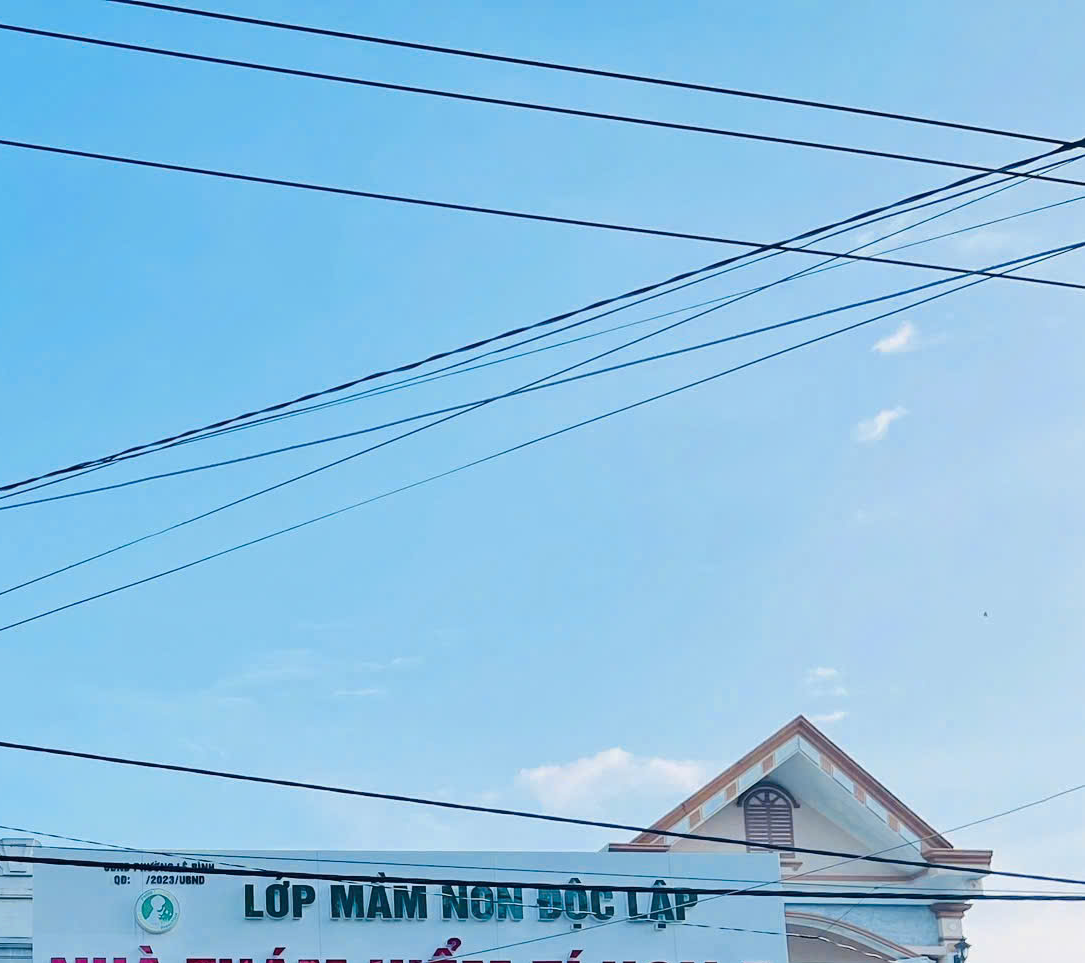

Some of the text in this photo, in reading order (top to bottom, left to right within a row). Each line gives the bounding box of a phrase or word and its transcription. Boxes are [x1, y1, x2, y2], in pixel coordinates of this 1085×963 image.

[145, 875, 206, 886] /2023/UBND
[244, 875, 316, 920] LỚP
[441, 883, 524, 922] NON
[537, 877, 615, 930] ĐỘC
[626, 879, 699, 930] LẬP
